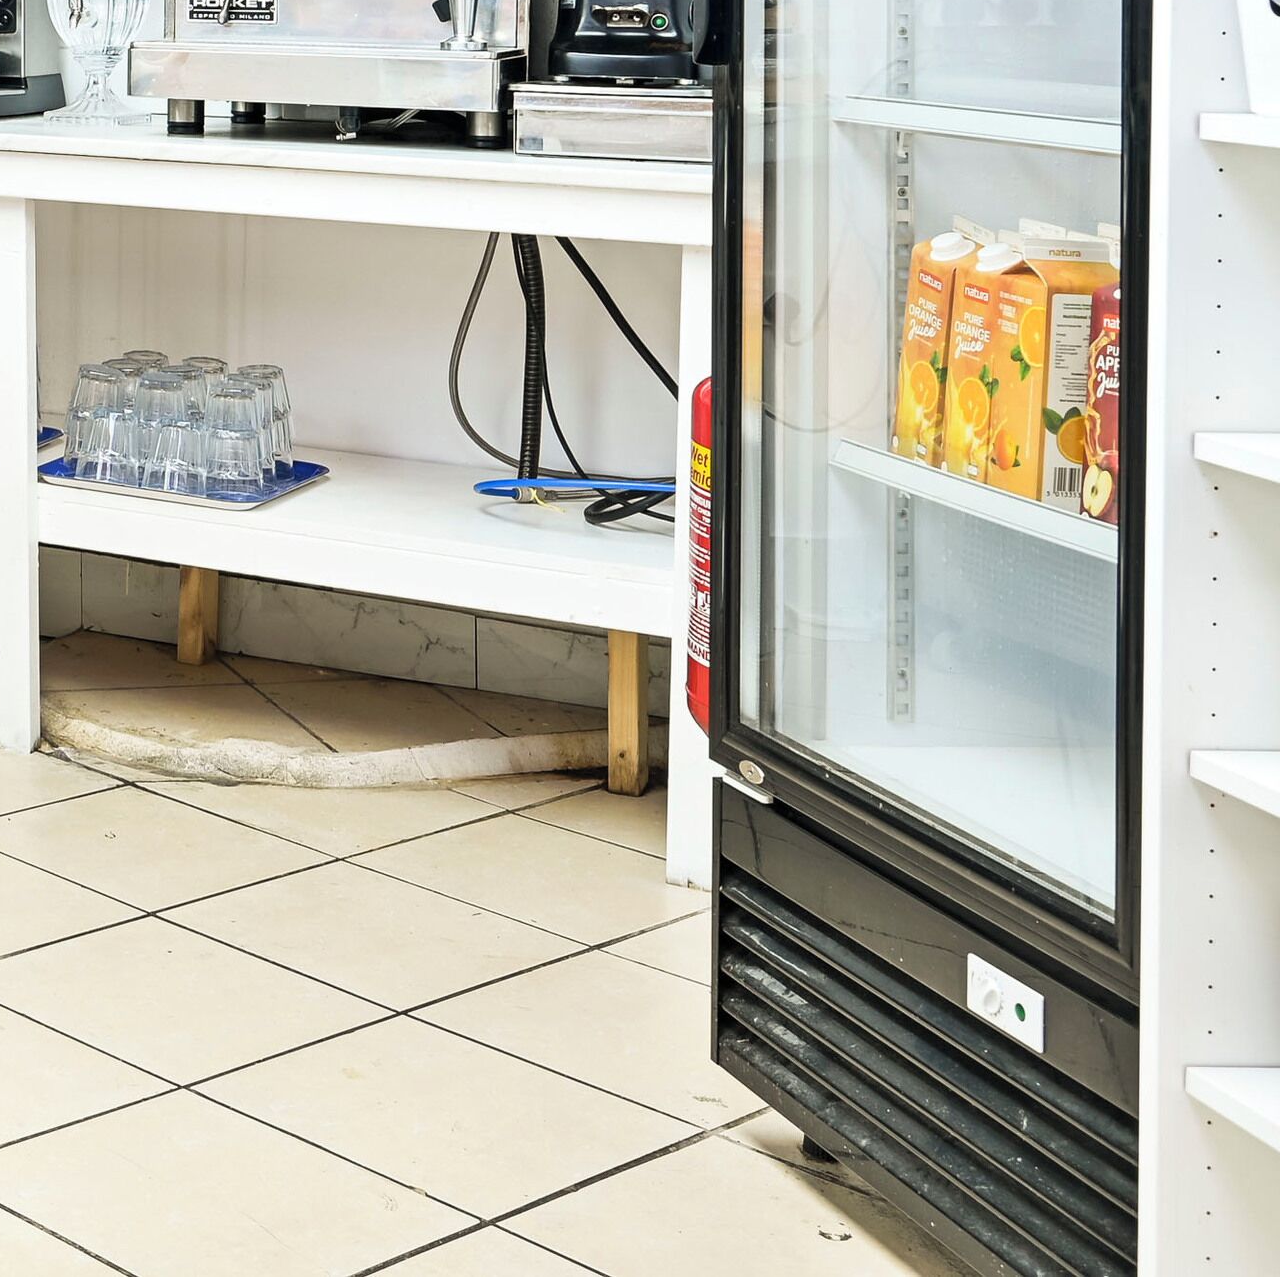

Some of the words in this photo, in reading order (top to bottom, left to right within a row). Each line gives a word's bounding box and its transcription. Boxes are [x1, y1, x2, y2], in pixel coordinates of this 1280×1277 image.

[1048, 248, 1081, 258] natura
[919, 272, 943, 291] natura
[964, 286, 990, 302] natura
[918, 297, 938, 315] PURE
[908, 303, 943, 331] ORANGE
[963, 312, 985, 328] PURE
[1103, 317, 1120, 330] nat
[907, 319, 938, 341] Juice
[954, 321, 992, 343] ORANGE
[954, 335, 986, 359] Juice
[1106, 344, 1120, 356] PU
[1095, 354, 1120, 373] APP
[1096, 371, 1120, 398] Jui
